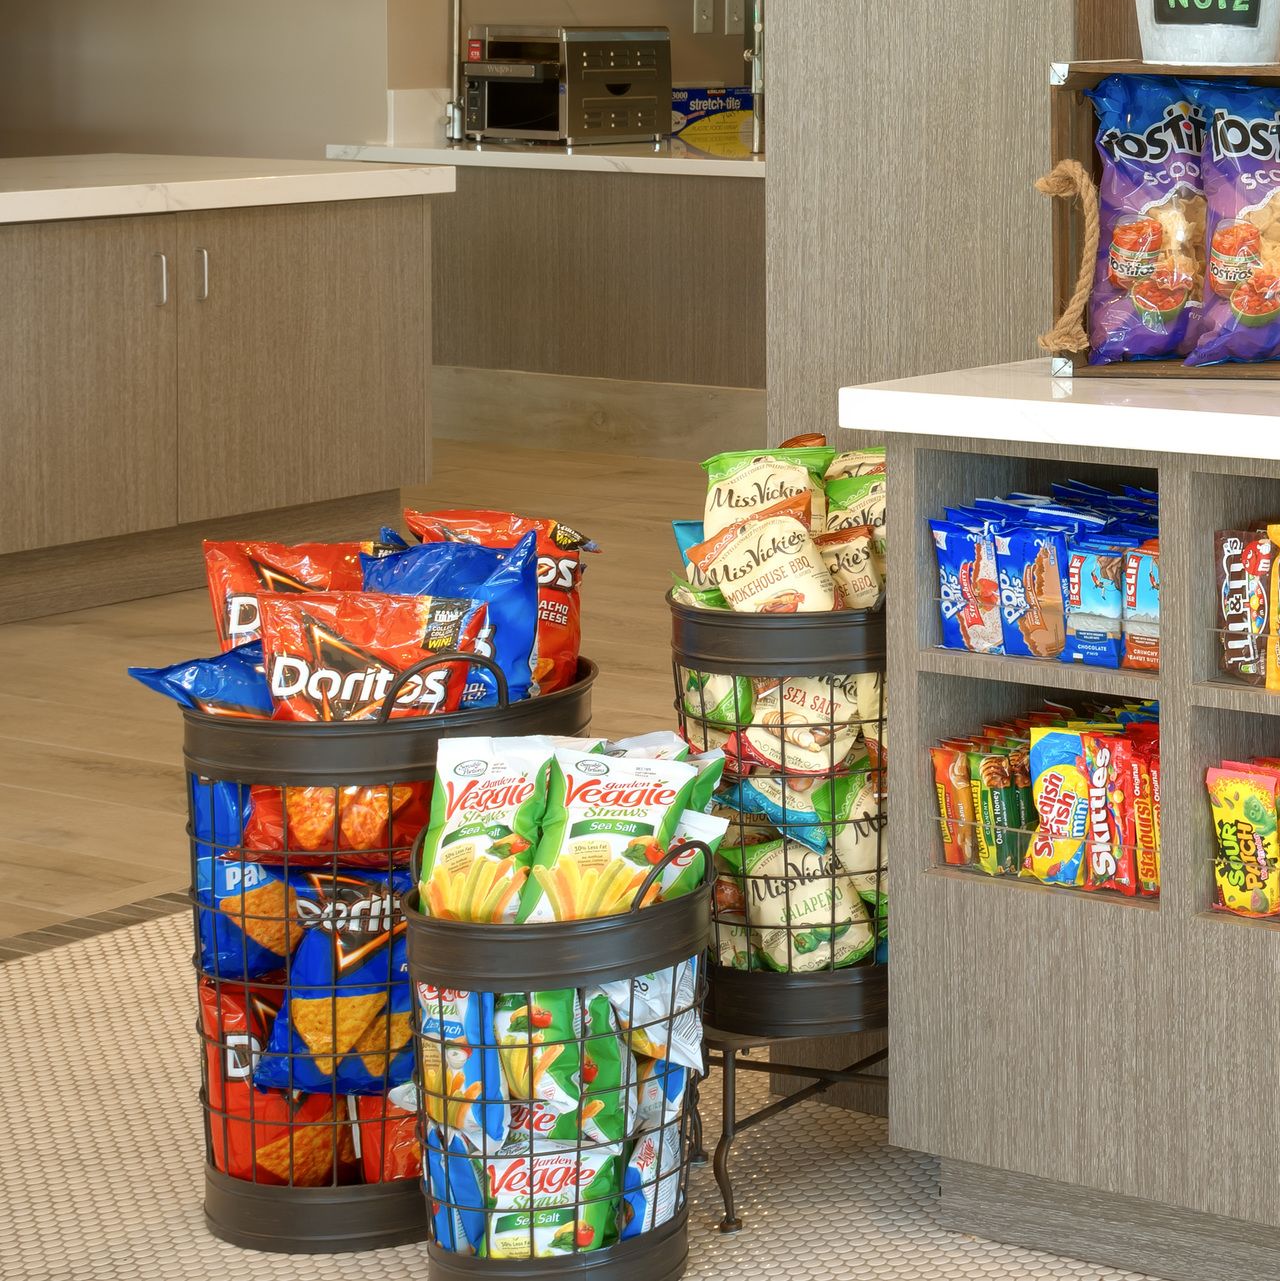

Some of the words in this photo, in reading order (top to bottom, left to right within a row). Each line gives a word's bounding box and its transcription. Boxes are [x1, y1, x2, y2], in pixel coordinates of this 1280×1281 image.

[689, 97, 741, 111] stretch-tite
[791, 556, 814, 573] BBQ
[1069, 558, 1082, 594] CLIF
[1126, 557, 1139, 595] CLIF
[852, 575, 877, 592] BBQ
[428, 637, 453, 649] WIN!
[1077, 644, 1107, 652] CHOCOLATE
[273, 655, 453, 706] Doritos
[784, 686, 808, 705] SEA
[810, 691, 843, 717] SALT
[565, 774, 677, 809] Veggie
[1132, 763, 1140, 796] Original
[446, 778, 536, 821] Veggie
[583, 805, 650, 818] Straws
[1033, 771, 1065, 858] Swedish
[1053, 790, 1077, 839] Fish
[1072, 797, 1089, 838] mini
[1089, 746, 1118, 877] Skittles
[459, 826, 480, 837] Sea
[589, 821, 612, 831] Sea
[615, 822, 637, 832] Salt
[1135, 796, 1155, 879] Starburst
[1221, 822, 1246, 887] SOUR
[1236, 821, 1265, 892] PATCH
[296, 891, 406, 932] Dorit
[487, 1158, 596, 1198] Veggie
[537, 1212, 561, 1225] Salt
